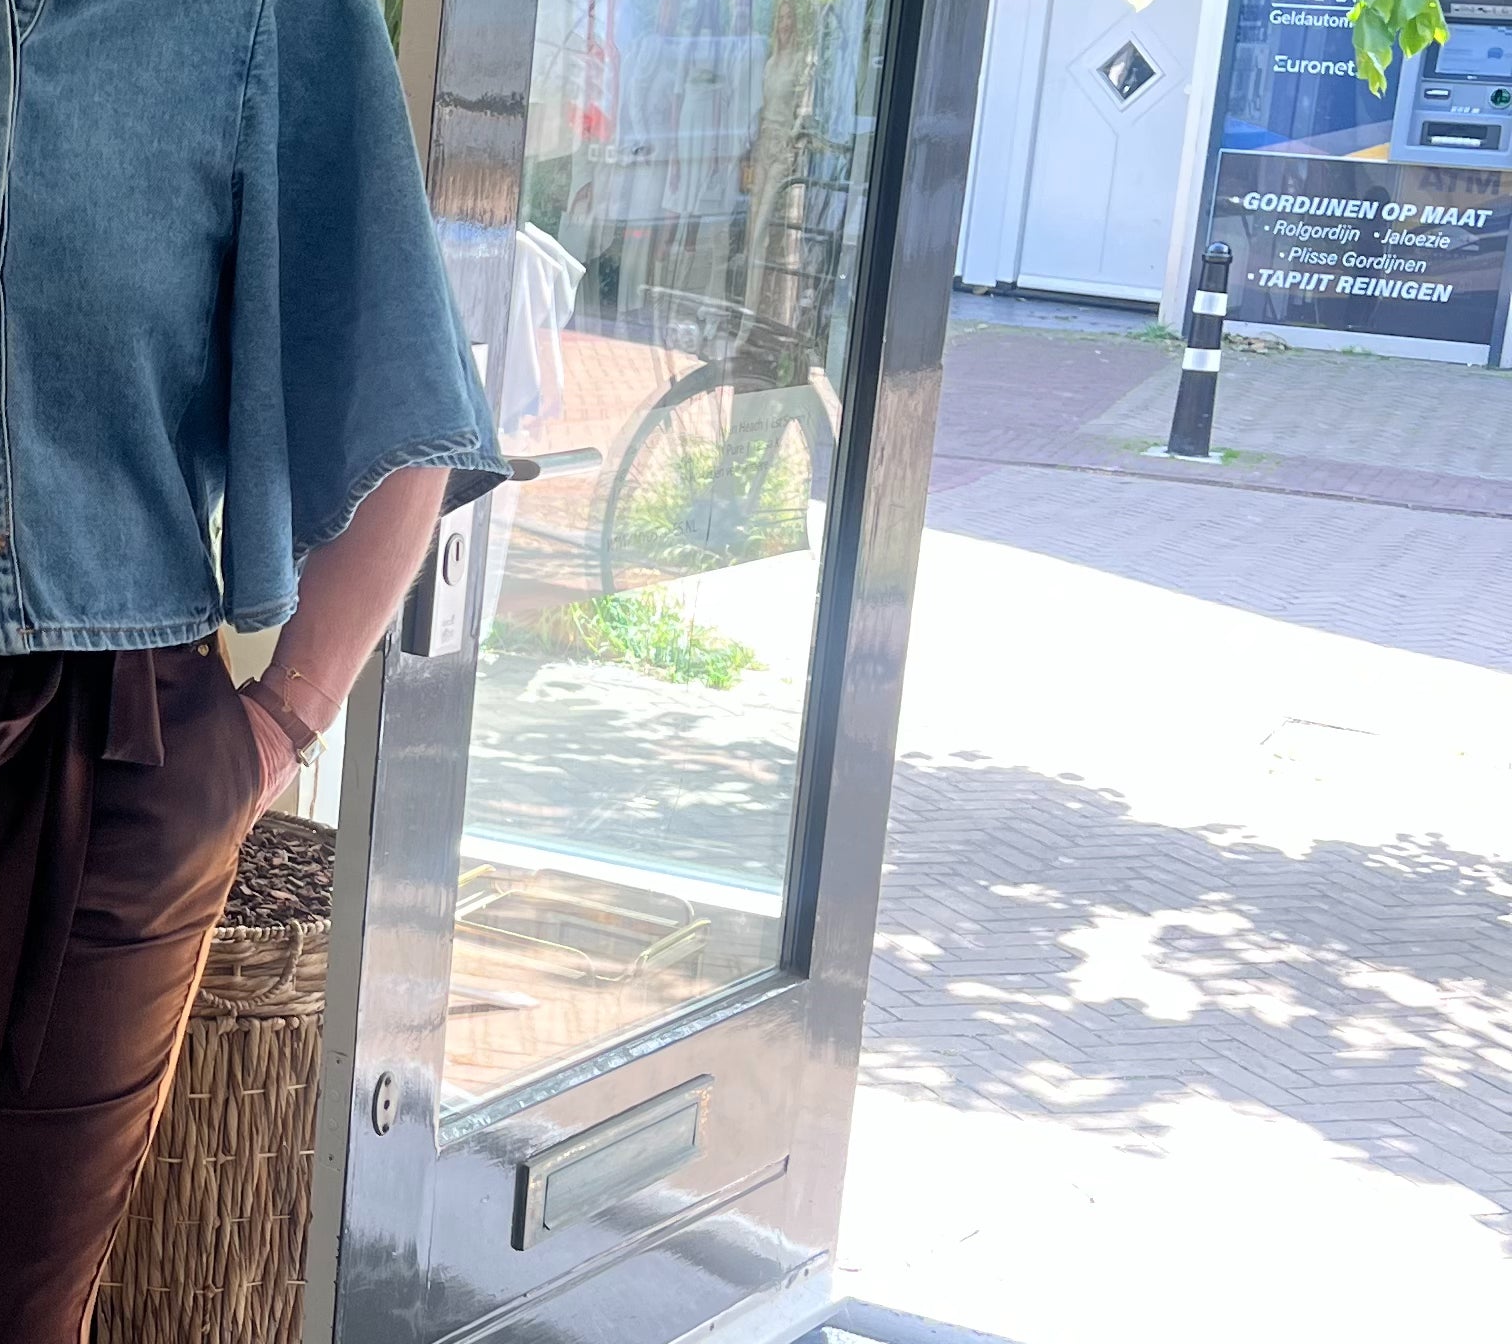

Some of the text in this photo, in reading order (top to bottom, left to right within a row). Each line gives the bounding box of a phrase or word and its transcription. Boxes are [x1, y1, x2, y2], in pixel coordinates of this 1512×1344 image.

[1269, 9, 1353, 28] Geldautom
[1273, 55, 1357, 77] Euronet
[1243, 191, 1493, 228] GORDIJNEN OP MAAT
[1273, 219, 1361, 243] Rolgordijn
[1382, 228, 1450, 249] Jaloezie
[1288, 247, 1427, 274] Plisse Gordijnen
[1258, 269, 1453, 303] TAPIJT REINIGEN
